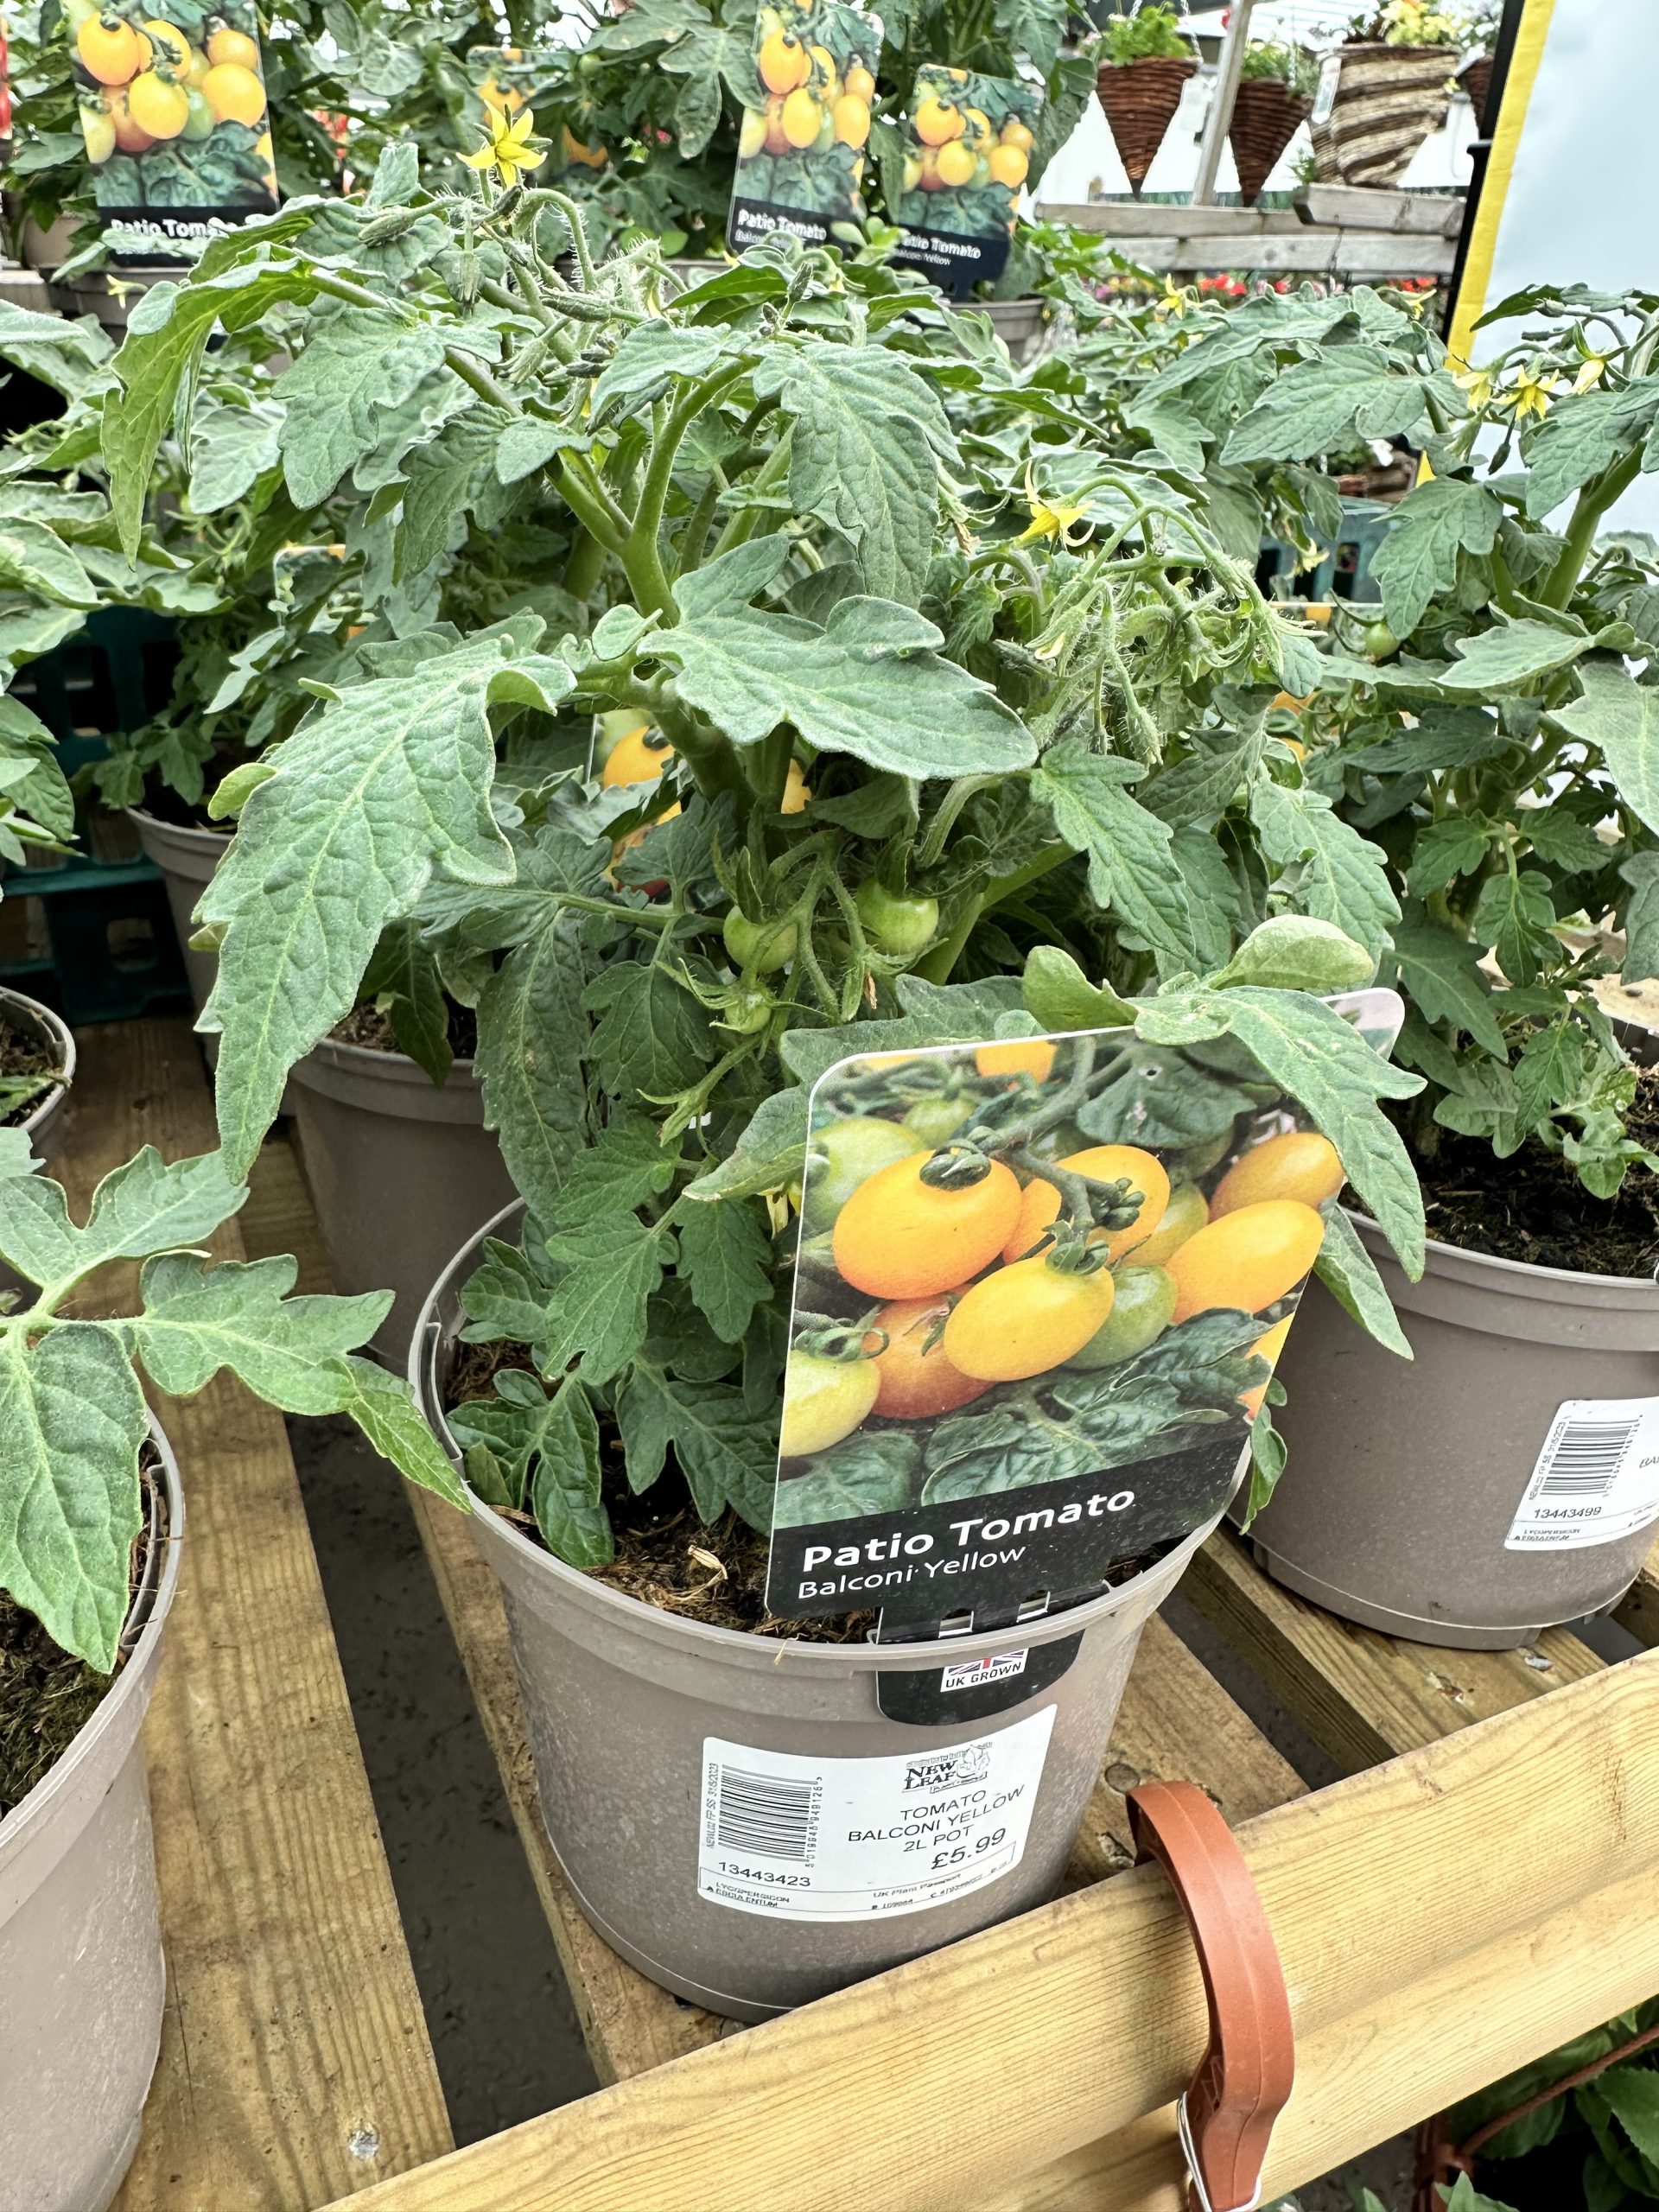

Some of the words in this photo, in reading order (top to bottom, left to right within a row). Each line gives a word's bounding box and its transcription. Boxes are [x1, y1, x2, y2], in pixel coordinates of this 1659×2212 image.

[738, 208, 776, 231] Patio
[902, 234, 930, 250] atio
[931, 237, 982, 259] Tomato
[802, 1532, 935, 1573] Patio
[950, 1491, 1135, 1547] Tomato
[798, 1567, 913, 1599] Balconi
[925, 1546, 1026, 1580] Yellow
[946, 1676, 965, 1688] UK
[970, 1662, 1021, 1683] GROWN
[904, 1771, 957, 1790] LEAF
[906, 1759, 958, 1777] NEW
[849, 1820, 941, 1841] BALCONI
[948, 1784, 1026, 1827] YELLOW
[900, 1789, 987, 1821] TOMATO
[903, 1840, 927, 1853] 2L
[933, 1824, 976, 1847] POT
[931, 1828, 1007, 1870] £5.99
[719, 1861, 810, 1887] 13443423
